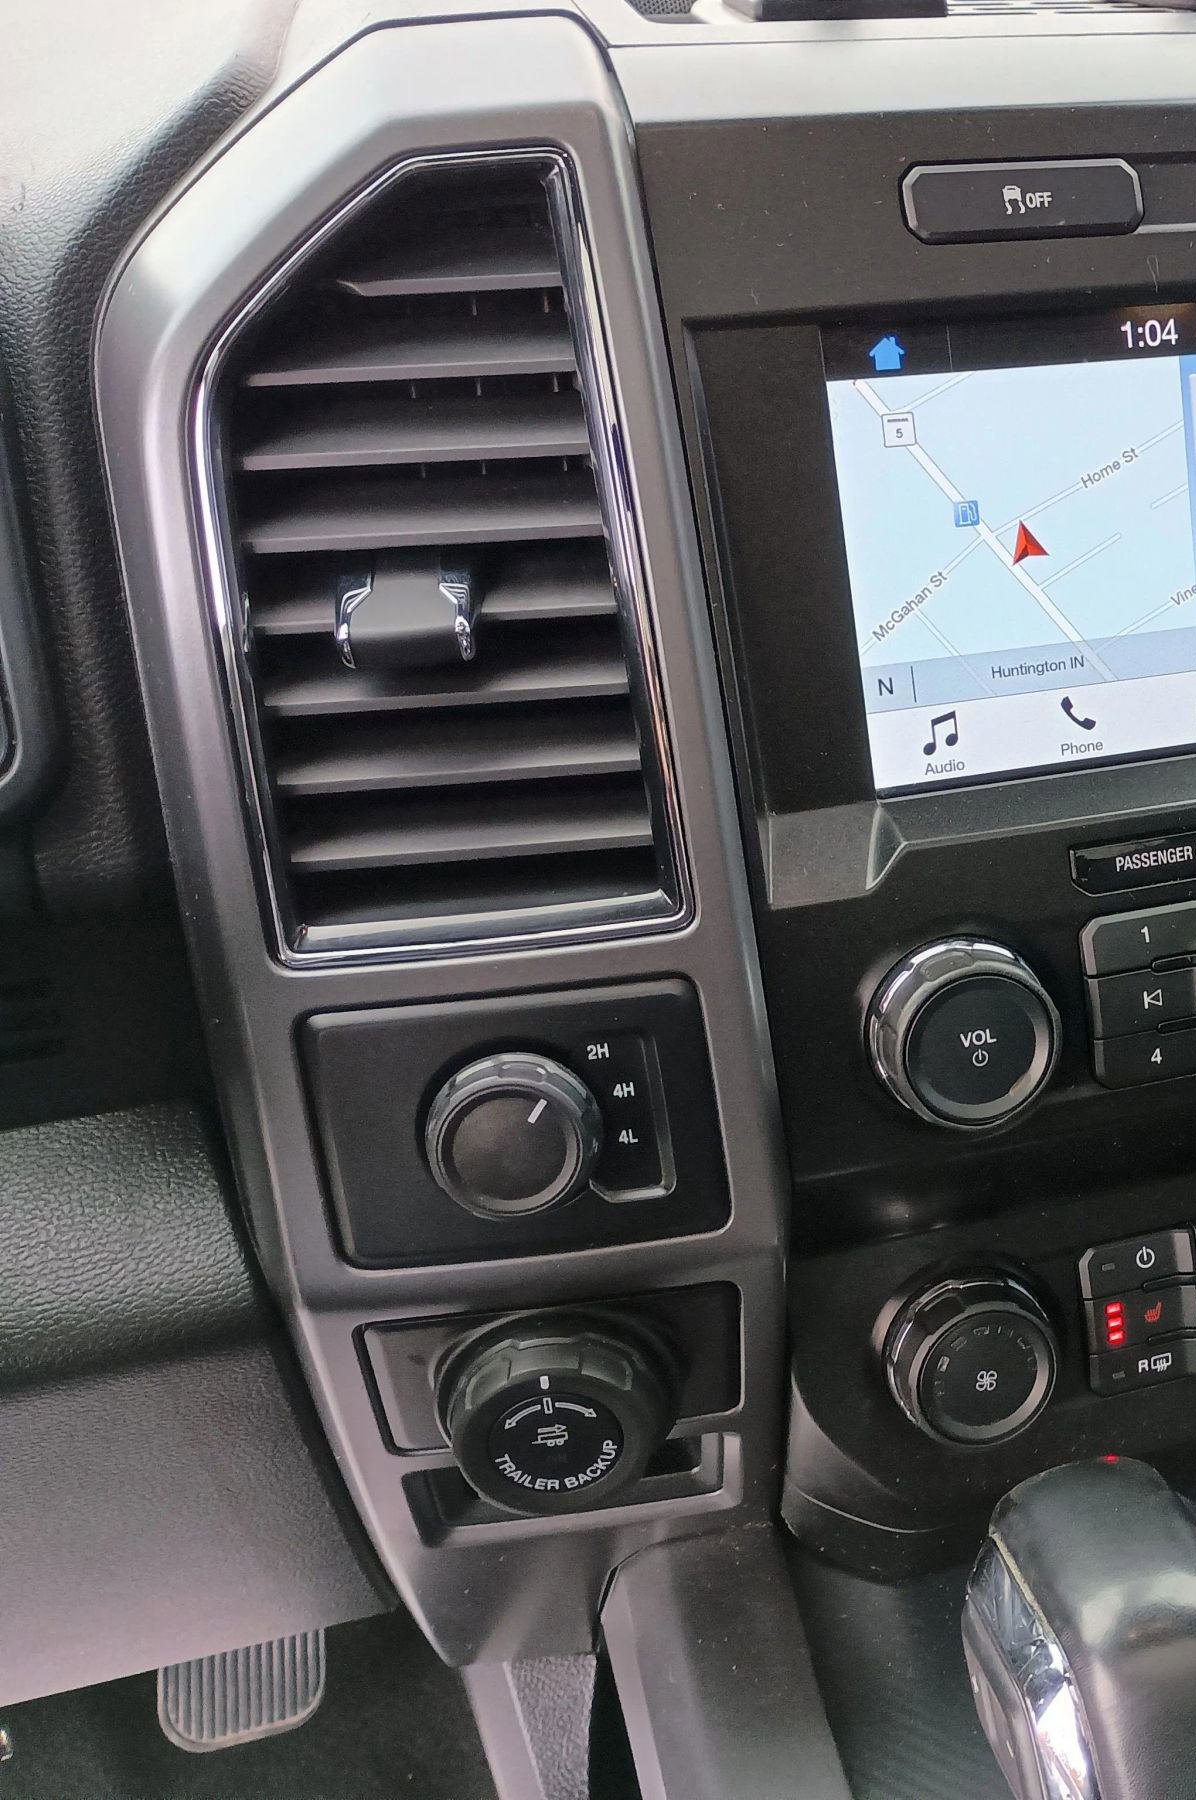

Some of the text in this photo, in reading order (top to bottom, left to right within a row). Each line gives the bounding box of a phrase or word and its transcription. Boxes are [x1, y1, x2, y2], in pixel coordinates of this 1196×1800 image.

[1025, 189, 1053, 209] OFF
[1120, 318, 1179, 349] 1:04
[895, 428, 904, 439] 5
[1080, 446, 1139, 489] Home St
[871, 570, 948, 642] McGahan St
[990, 655, 1086, 680] Huntington IN
[877, 676, 895, 697] N
[1060, 740, 1104, 757] Phone
[924, 759, 966, 776] Audio
[1115, 846, 1193, 873] PASSENGER
[1140, 926, 1151, 944] 1
[959, 1028, 998, 1049] VOL
[586, 1042, 610, 1060] 2H
[1150, 1048, 1163, 1065] 4
[612, 1081, 635, 1099] 4H
[618, 1129, 639, 1145] 4L
[1137, 1359, 1149, 1374] R
[494, 1439, 618, 1491] TRAILER BACKUP
